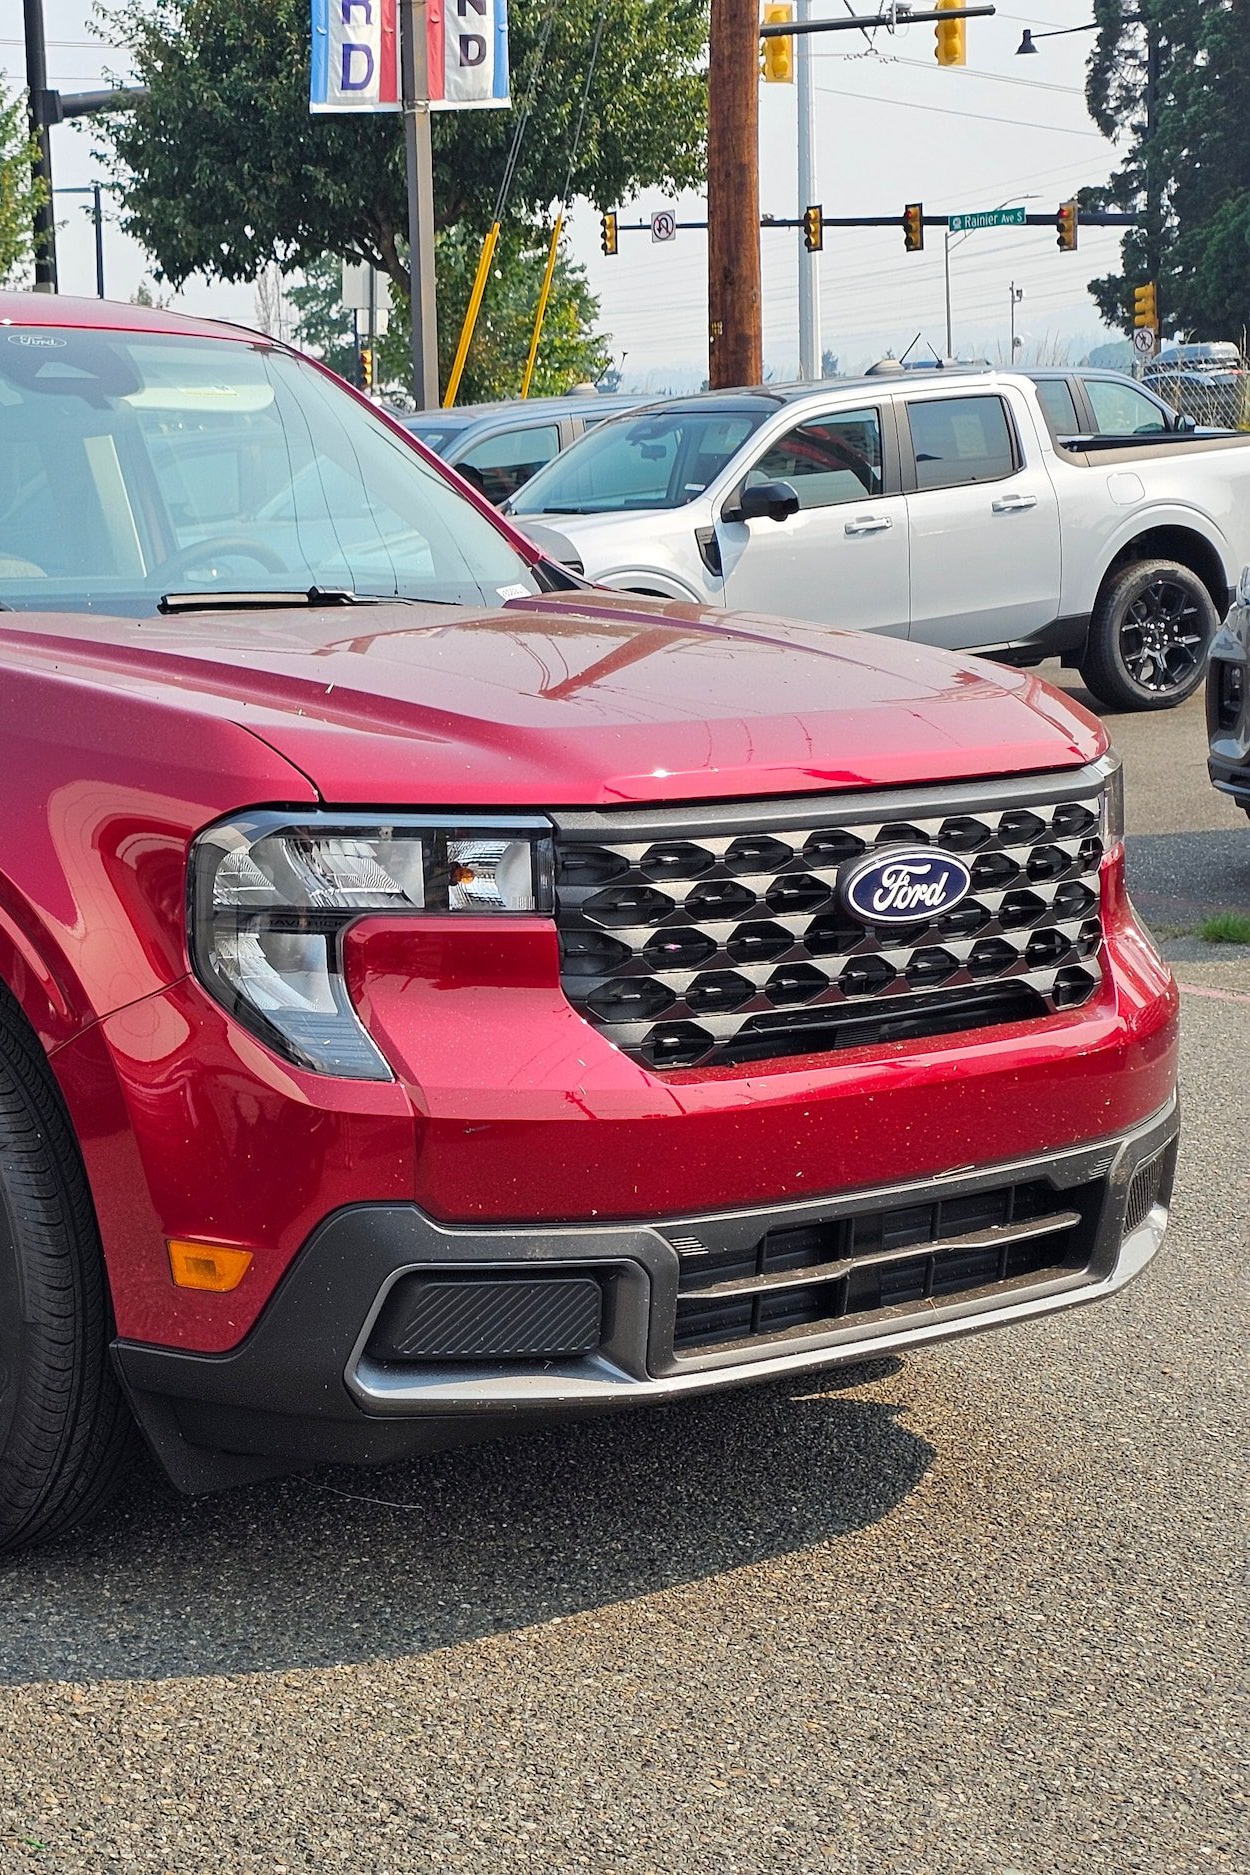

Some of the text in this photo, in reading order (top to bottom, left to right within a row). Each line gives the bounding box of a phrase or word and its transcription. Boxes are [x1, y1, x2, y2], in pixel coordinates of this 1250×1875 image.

[964, 211, 1023, 229] Rainier Ave S
[872, 863, 950, 912] Ford
